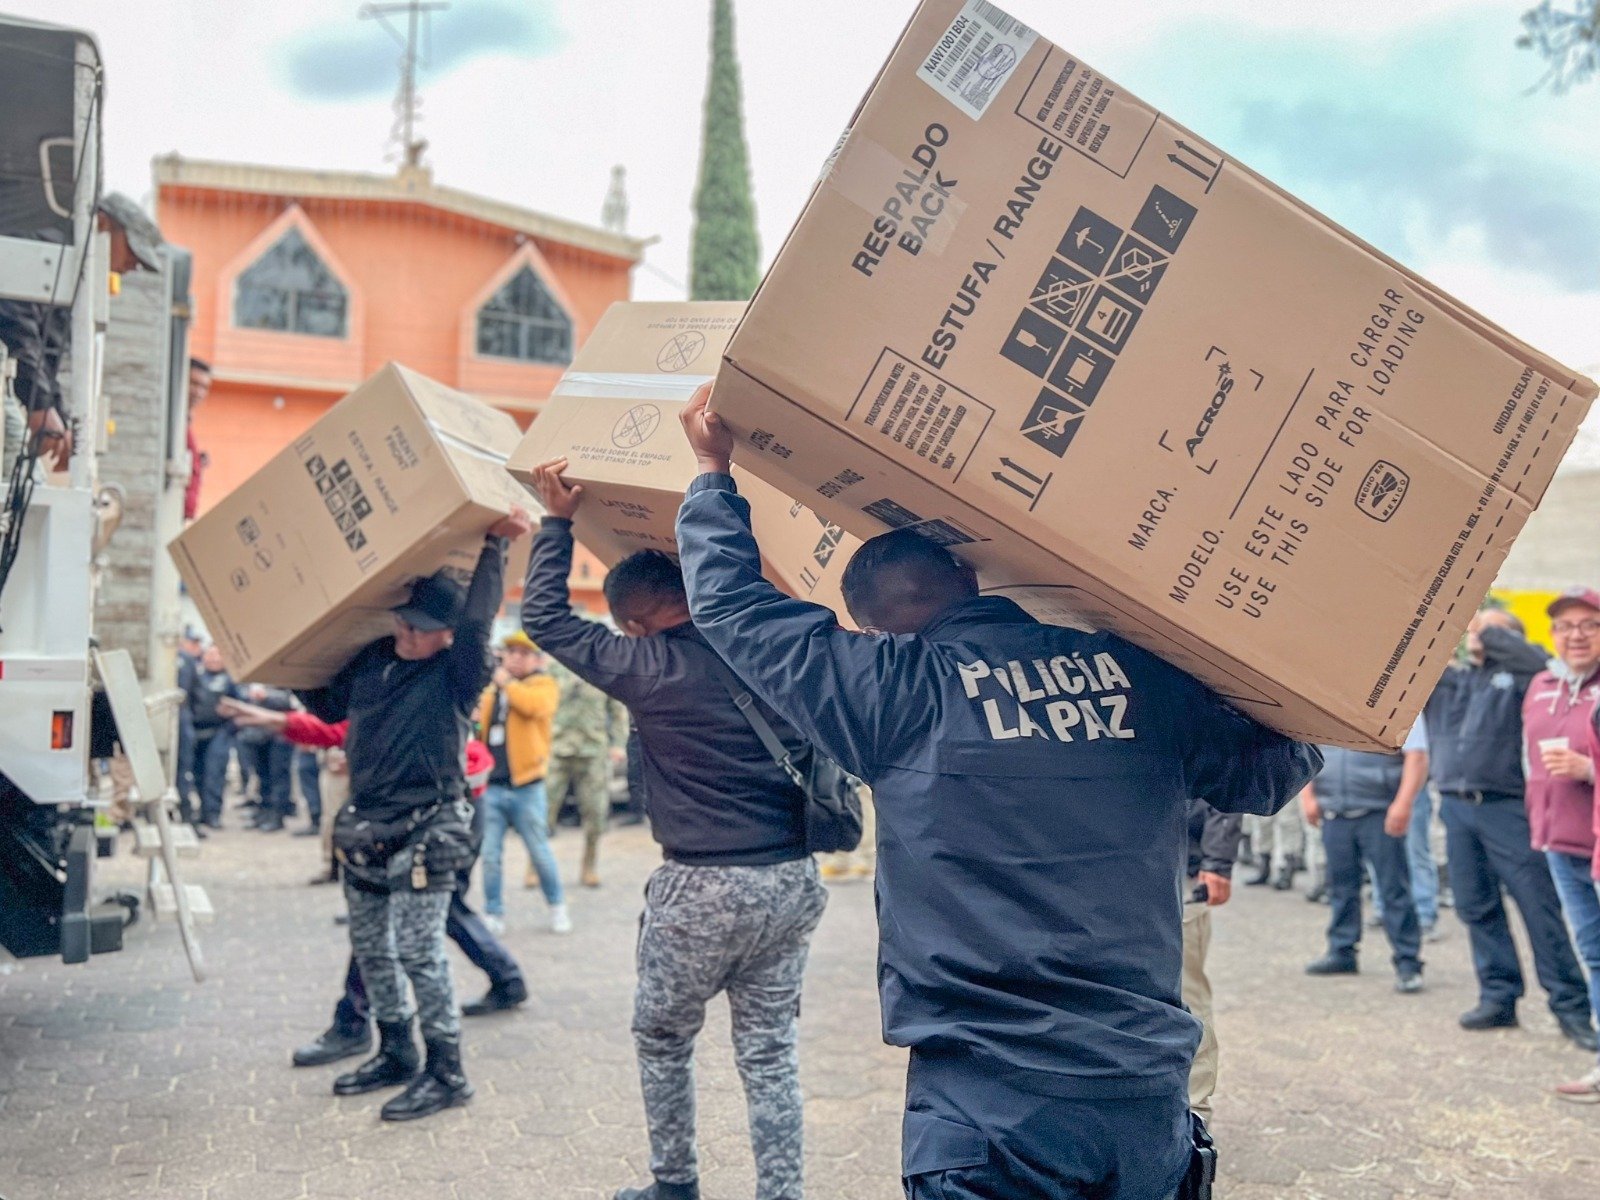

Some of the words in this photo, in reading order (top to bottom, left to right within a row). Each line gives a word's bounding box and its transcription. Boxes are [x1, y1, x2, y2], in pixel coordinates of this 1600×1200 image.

[923, 15, 970, 73] NAW1001B04
[1082, 96, 1093, 106] LA
[850, 121, 950, 277] RESPALDO
[992, 136, 1063, 240] RANGE
[896, 170, 958, 256] BACK
[984, 238, 1007, 259] /
[920, 258, 998, 370] ESTUFA
[1096, 309, 1107, 321] 4
[912, 394, 924, 406] THE
[917, 384, 930, 397] TOP
[923, 401, 937, 416] MAY
[916, 441, 931, 458] OVER
[924, 433, 935, 444] ON
[932, 416, 945, 429] THE
[1183, 376, 1234, 457] ACROS
[1492, 398, 1518, 435] UNIDAD
[392, 424, 419, 467] FRENTE
[591, 446, 607, 454] PARE
[608, 448, 629, 456] SOBRE
[639, 452, 672, 461] EMPAQUE
[932, 444, 945, 457] THE
[1214, 566, 1250, 609] USE
[1244, 504, 1284, 558] ESTE
[1278, 441, 1319, 495] LADO
[1315, 378, 1355, 431] PARA
[1349, 287, 1404, 368] CARGAR
[1242, 576, 1276, 619] USE
[1270, 518, 1309, 567] THIS
[1305, 456, 1343, 508] SIDE
[1338, 405, 1372, 448] FOR
[1366, 307, 1426, 396] LOADING
[1358, 476, 1375, 503] HECHO
[1373, 463, 1384, 474] EN
[1382, 479, 1406, 516] MEXICO
[1127, 483, 1178, 551] MARCA.
[1167, 526, 1225, 604] MODELO.
[1365, 672, 1391, 708] CARRETERA
[1384, 626, 1416, 674] PANAMERICANA
[1437, 553, 1456, 578] CELAYA
[982, 699, 1050, 741] LA
[1045, 694, 1135, 743] PAZ
